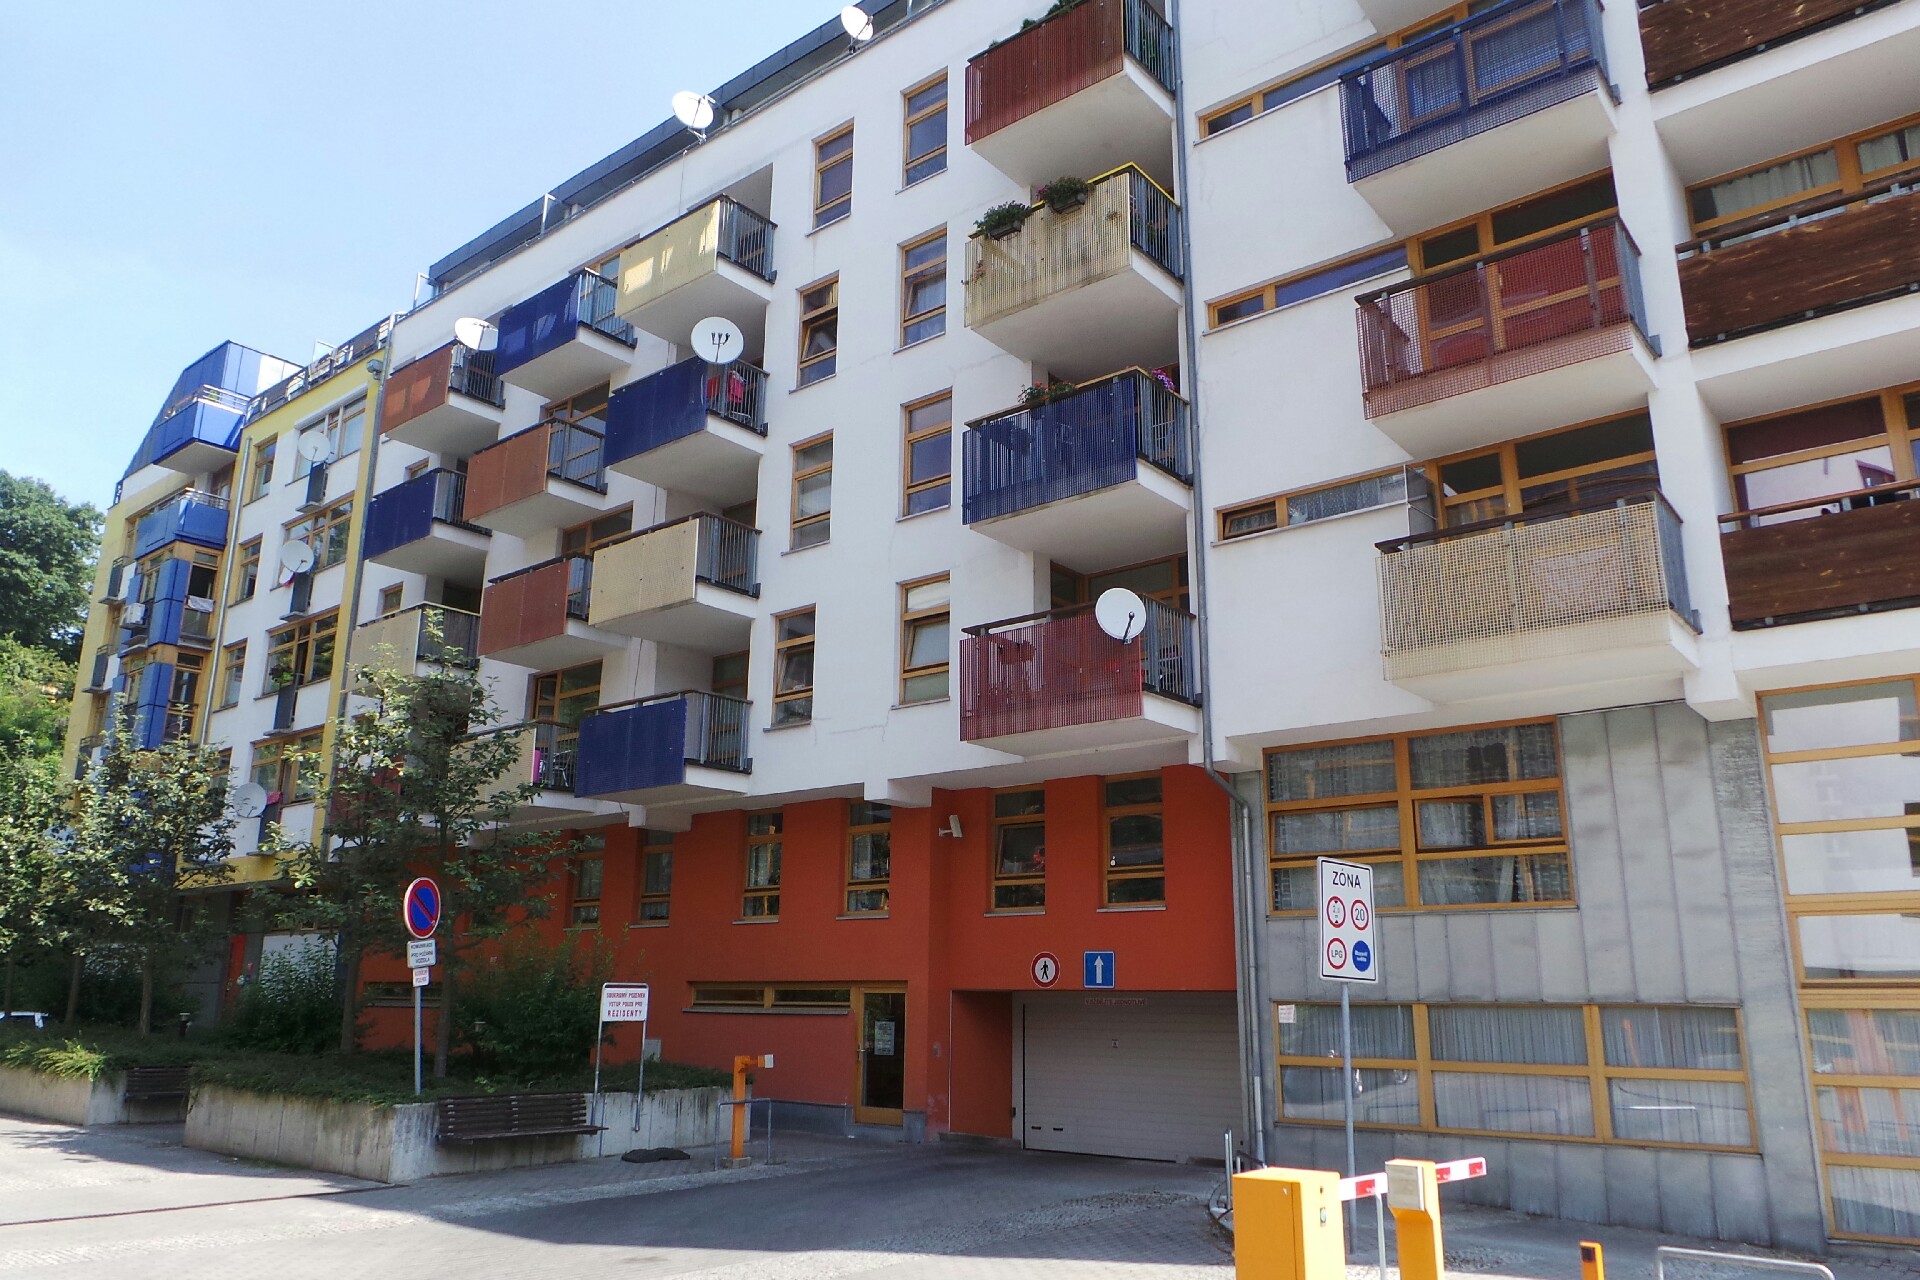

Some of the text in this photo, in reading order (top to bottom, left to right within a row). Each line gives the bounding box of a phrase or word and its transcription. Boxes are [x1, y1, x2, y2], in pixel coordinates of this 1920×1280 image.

[1332, 868, 1362, 890] ZÓNA
[1355, 908, 1365, 921] 20
[1331, 949, 1343, 959] LPG
